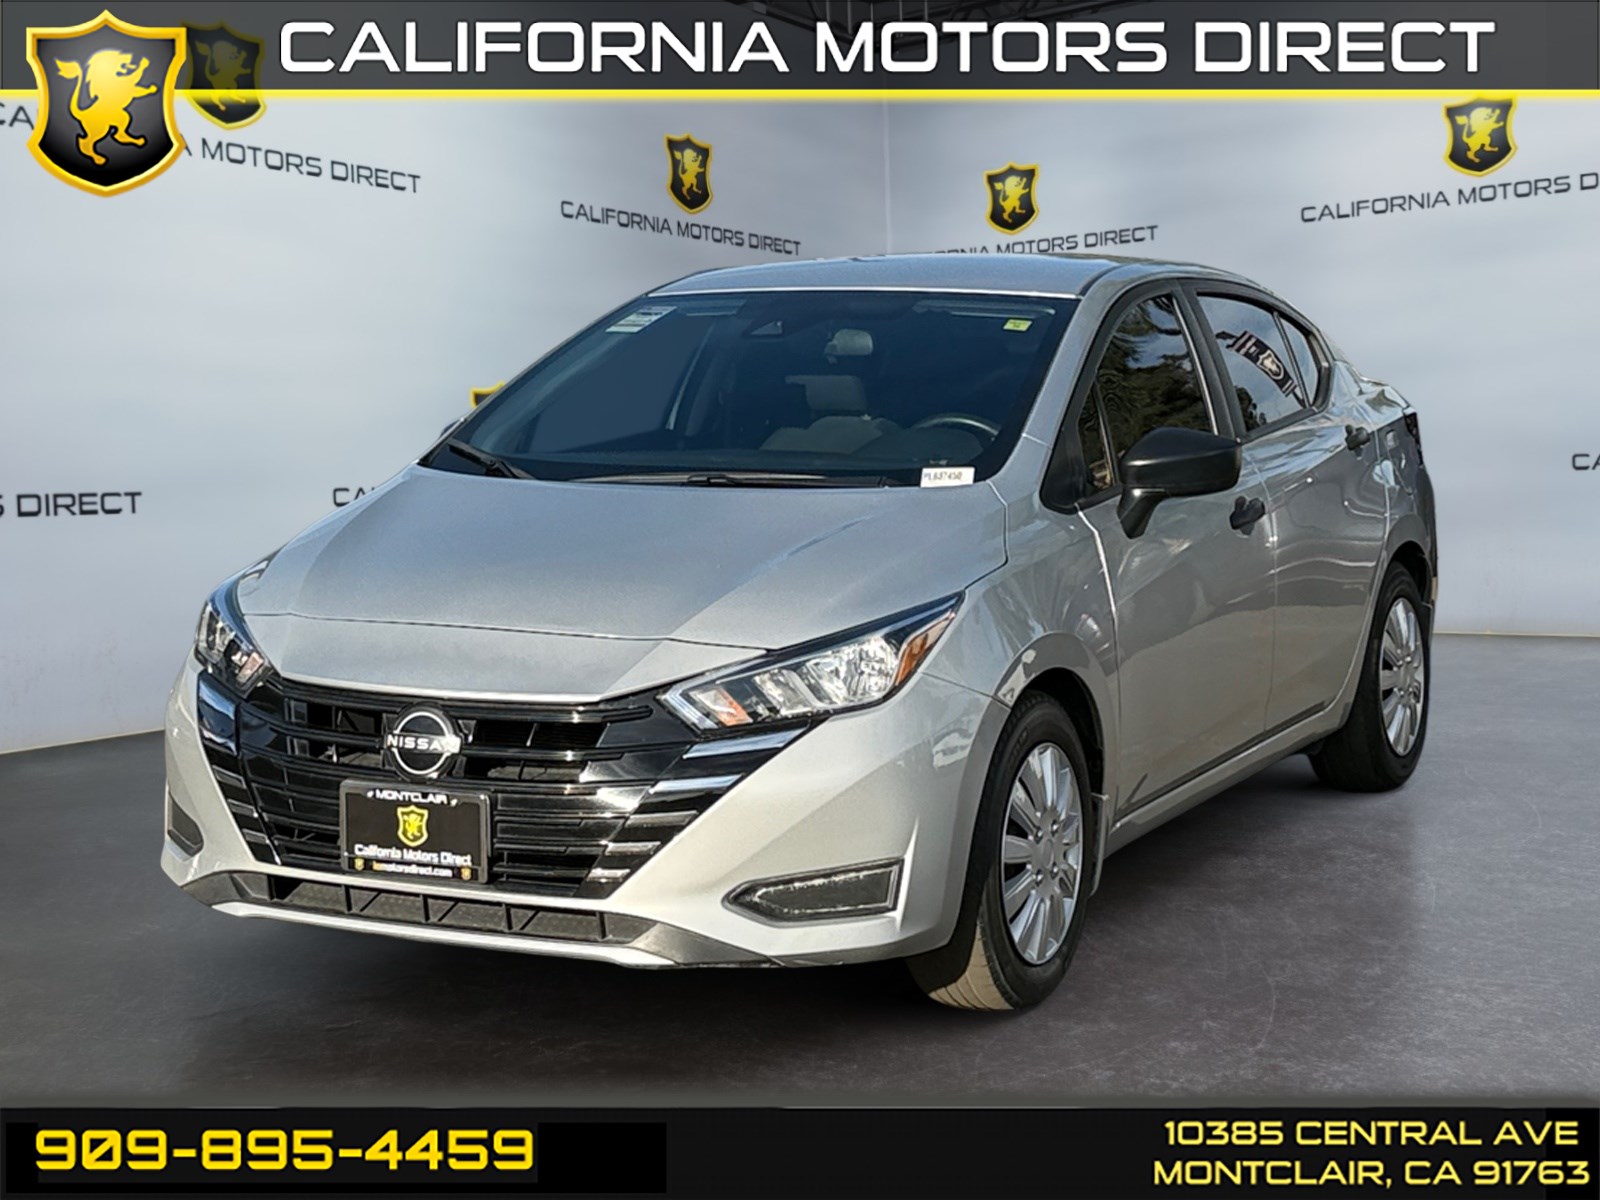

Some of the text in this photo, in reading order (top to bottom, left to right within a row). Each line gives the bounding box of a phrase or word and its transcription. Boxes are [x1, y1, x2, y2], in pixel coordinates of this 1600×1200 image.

[201, 137, 323, 178] MOTORS
[330, 159, 422, 194] DIRECT
[1300, 190, 1451, 223] CALIFORNIA
[1457, 175, 1572, 205] MOTORS
[560, 200, 801, 256] CALIFORNIA MOTORS DIRECT
[996, 234, 1079, 254] MOTORS
[1084, 224, 1159, 248] DIRECT
[16, 491, 143, 518] DIRECT
[375, 788, 449, 805] MONTCLAIR
[354, 843, 473, 868] California Motors Direct
